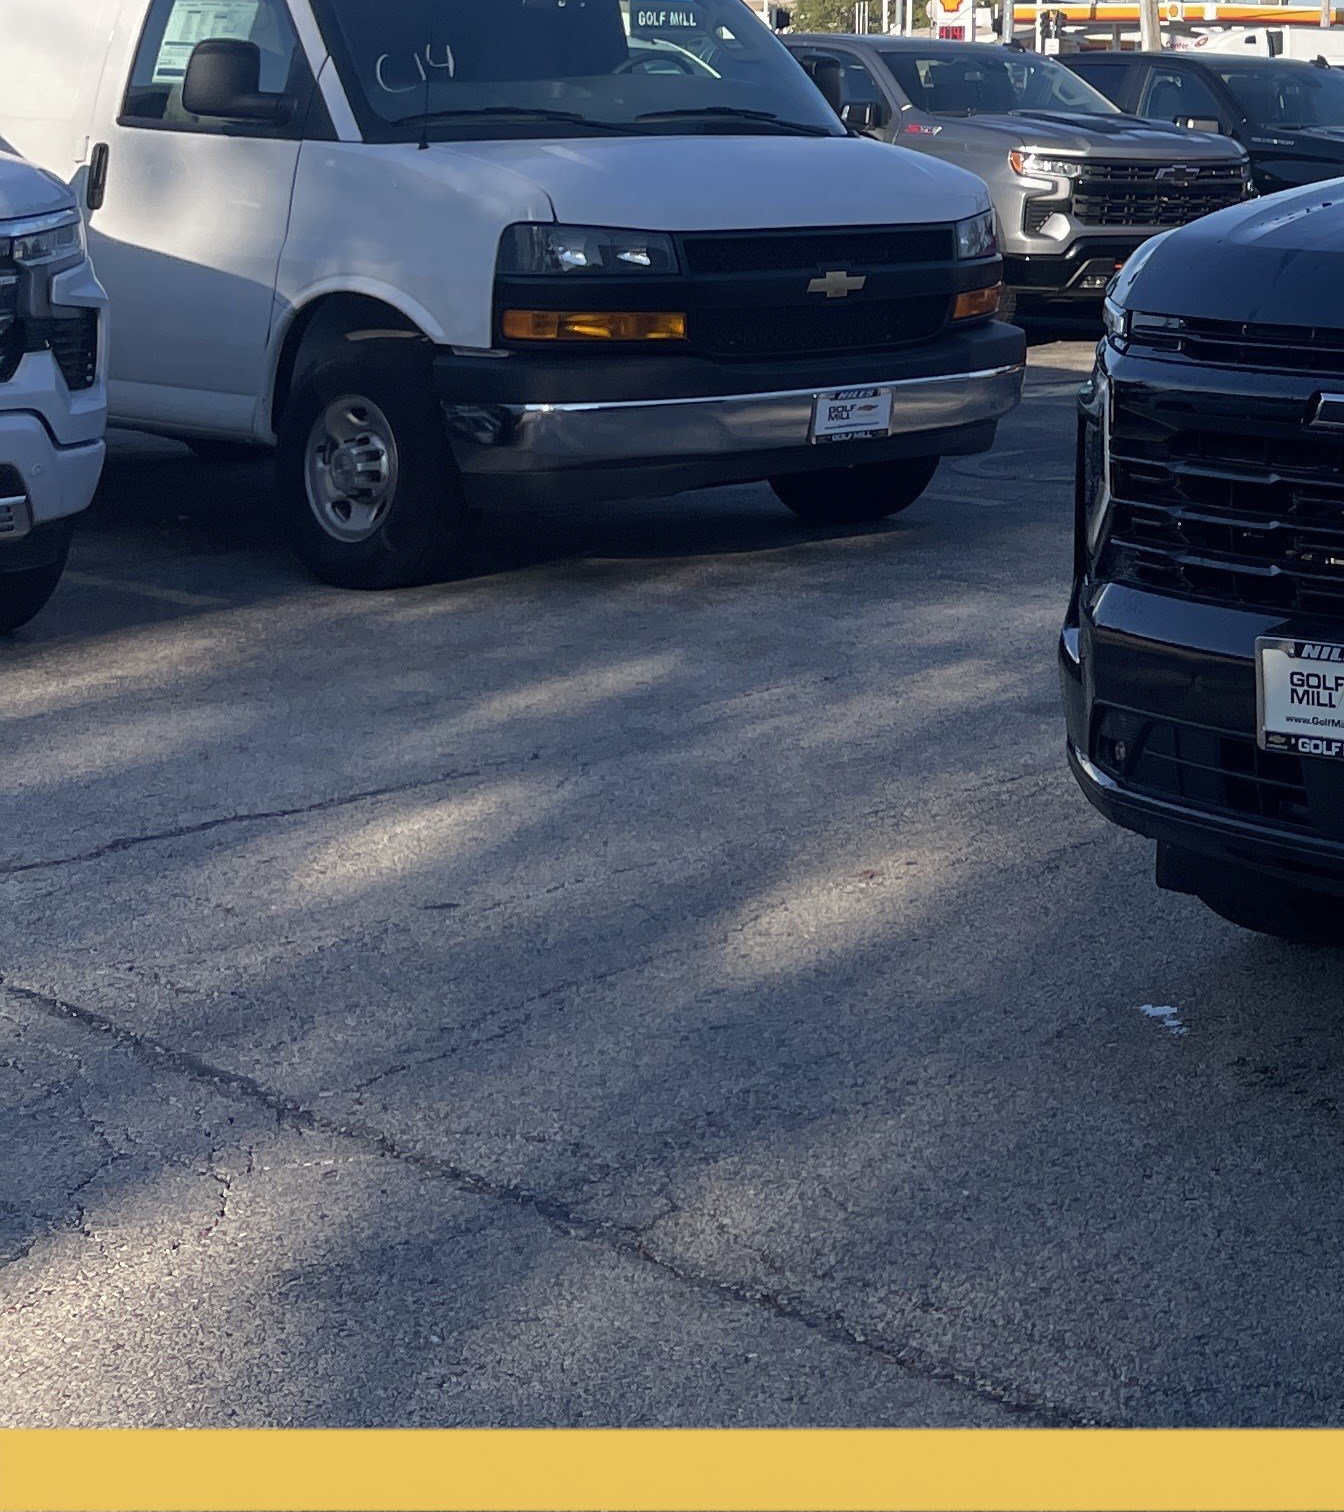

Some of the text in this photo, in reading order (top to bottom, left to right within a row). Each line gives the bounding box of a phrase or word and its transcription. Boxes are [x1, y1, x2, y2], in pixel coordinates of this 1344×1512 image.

[638, 11, 697, 26] GOLF MILL
[1290, 689, 1336, 709] MILL
[1298, 738, 1341, 756] GOLF
